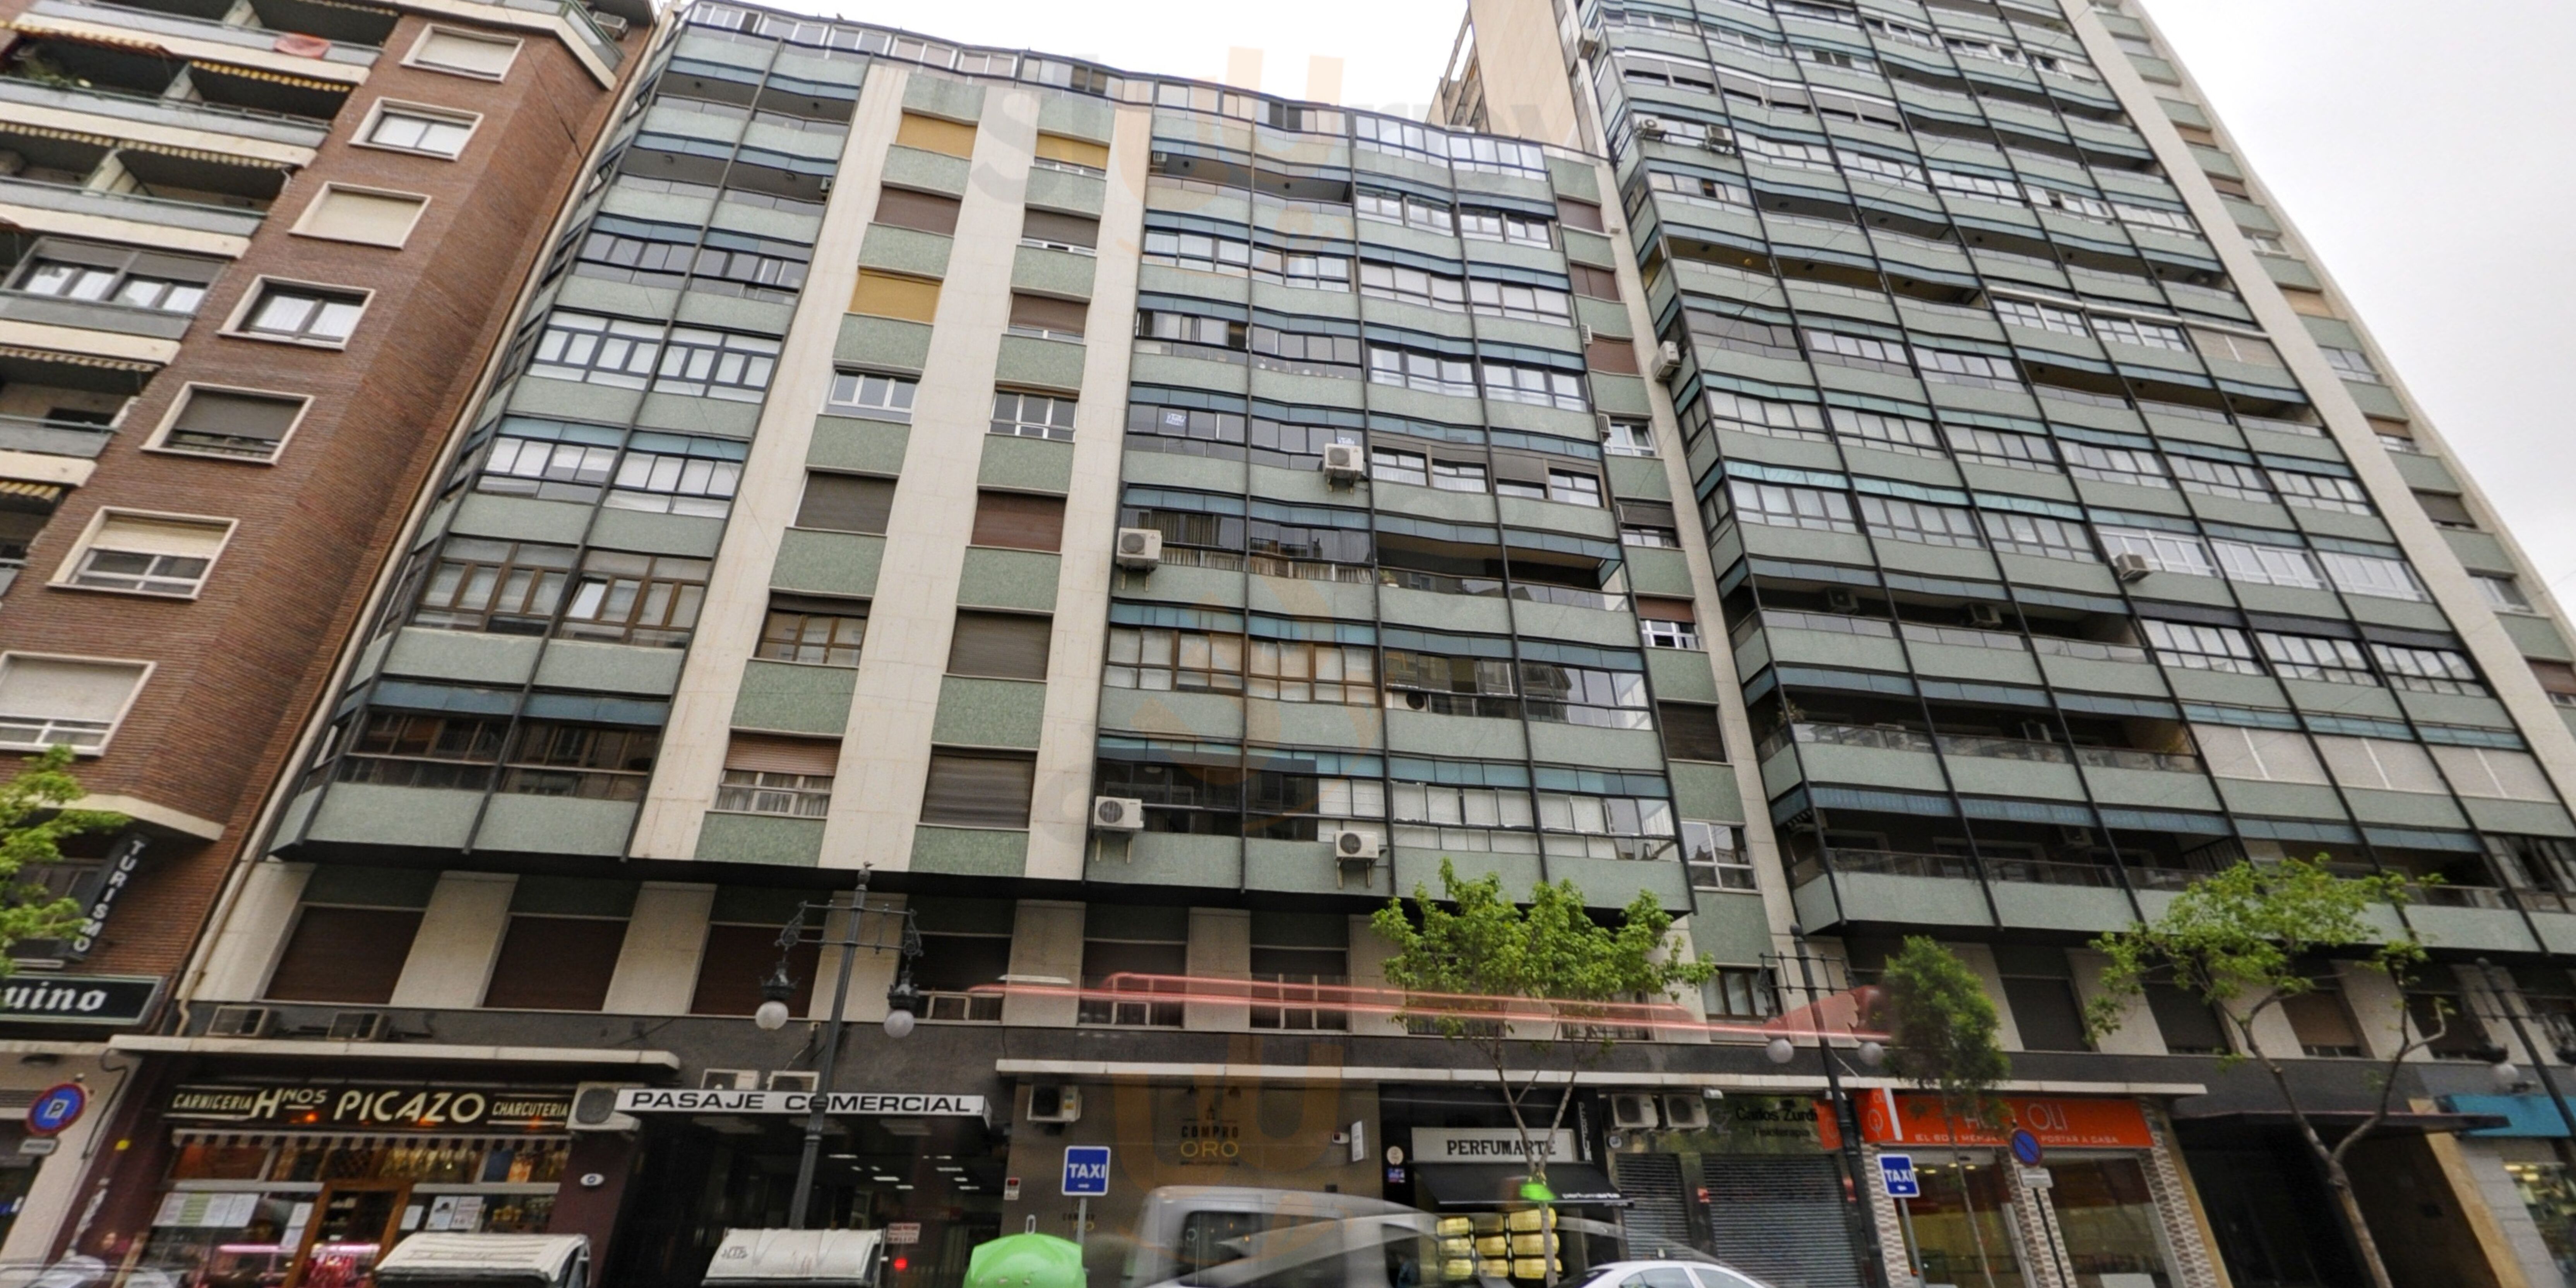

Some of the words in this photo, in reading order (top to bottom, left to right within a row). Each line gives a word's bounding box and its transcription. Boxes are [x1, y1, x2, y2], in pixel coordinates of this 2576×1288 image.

[73, 840, 145, 952] TURISMO
[49, 1102, 64, 1115] P
[172, 1093, 253, 1110] CARNICERIA
[333, 1090, 485, 1124] PICAZO
[492, 1101, 569, 1117] CHARCUTERIA
[630, 1092, 764, 1109] PASAJE
[785, 1095, 971, 1112] COMERCIAL
[1735, 1107, 1779, 1121] Carlos
[2027, 1103, 2069, 1131] OLI
[1181, 1125, 1239, 1138] COMPRO
[1180, 1140, 1240, 1158] ORO
[1447, 1140, 1557, 1156] PERFUMARTE
[1068, 1163, 1106, 1179] TAXI
[1885, 1169, 1914, 1182] TAXI
